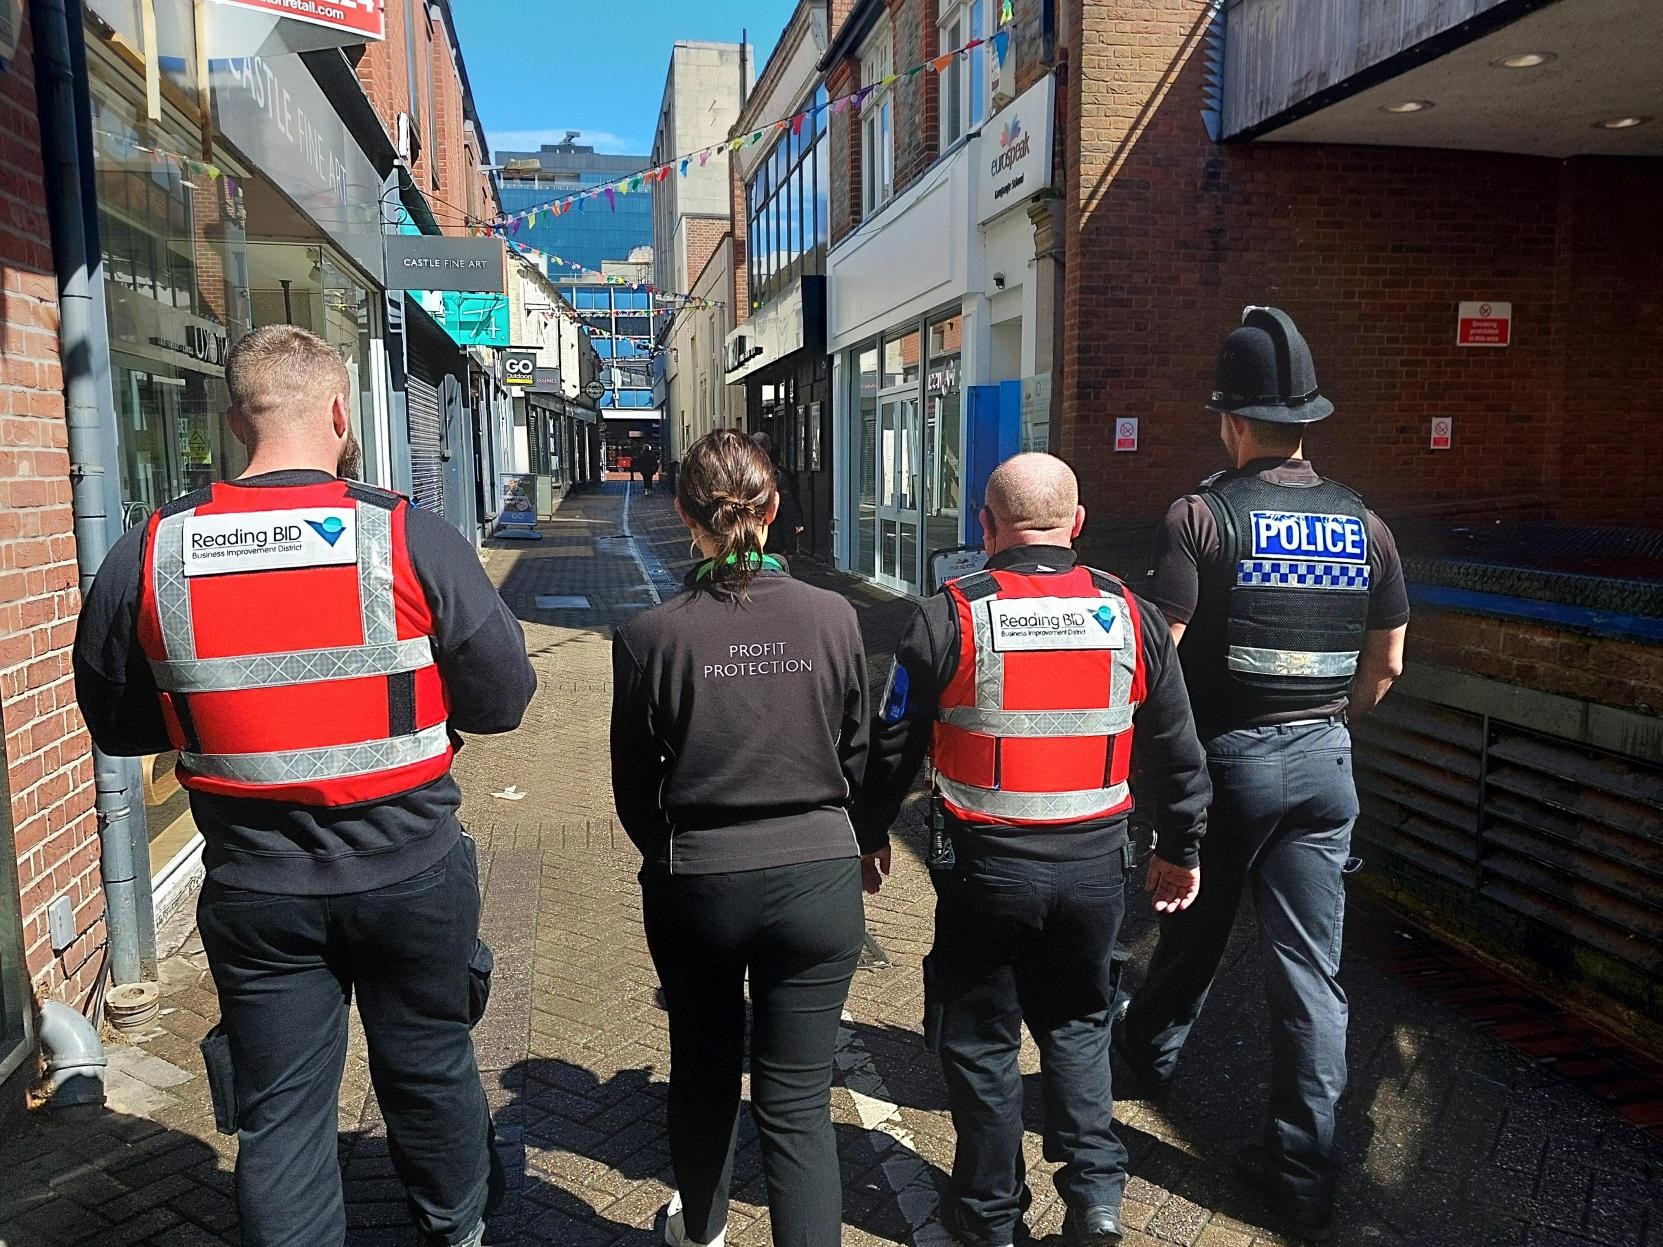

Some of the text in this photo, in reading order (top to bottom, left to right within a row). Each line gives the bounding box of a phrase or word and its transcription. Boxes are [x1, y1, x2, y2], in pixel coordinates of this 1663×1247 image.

[297, 106, 327, 182] FINE
[329, 150, 347, 206] ART
[991, 130, 1030, 177] eurospeak
[403, 258, 487, 269] CASTLE FINE ART
[505, 358, 533, 374] GO
[192, 525, 302, 548] Reading BID
[1258, 517, 1362, 554] POLICE
[192, 543, 302, 559] Business Improvement District
[1000, 612, 1085, 630] Reading BID
[1001, 628, 1086, 638] Business Improvement District
[729, 641, 787, 658] PROFIT
[704, 659, 812, 678] PROTECTION
